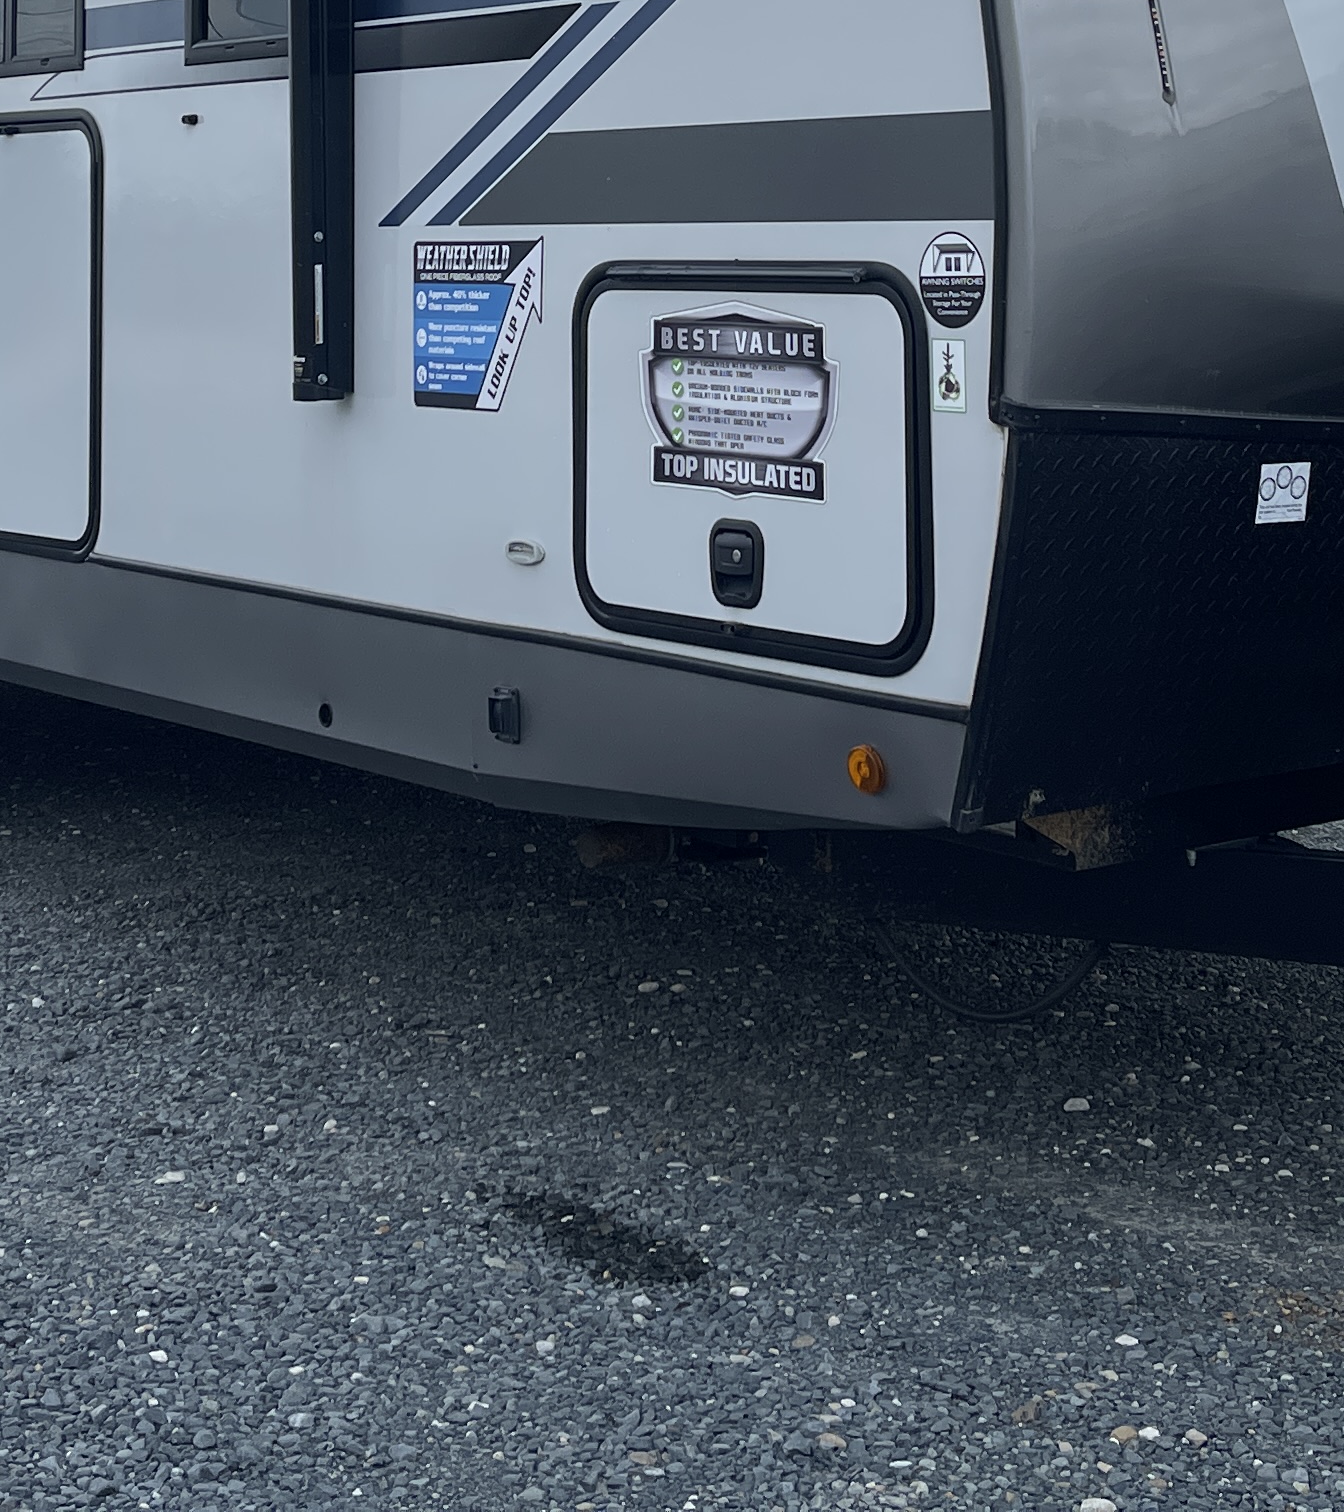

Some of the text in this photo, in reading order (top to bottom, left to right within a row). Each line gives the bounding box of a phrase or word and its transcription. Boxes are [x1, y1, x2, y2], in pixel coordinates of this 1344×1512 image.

[921, 277, 984, 286] AWNING SWITCHES
[487, 266, 536, 400] LOOK UP TOP!
[661, 326, 816, 358] BEST VALUE
[661, 453, 816, 492] TOP INSULATED
